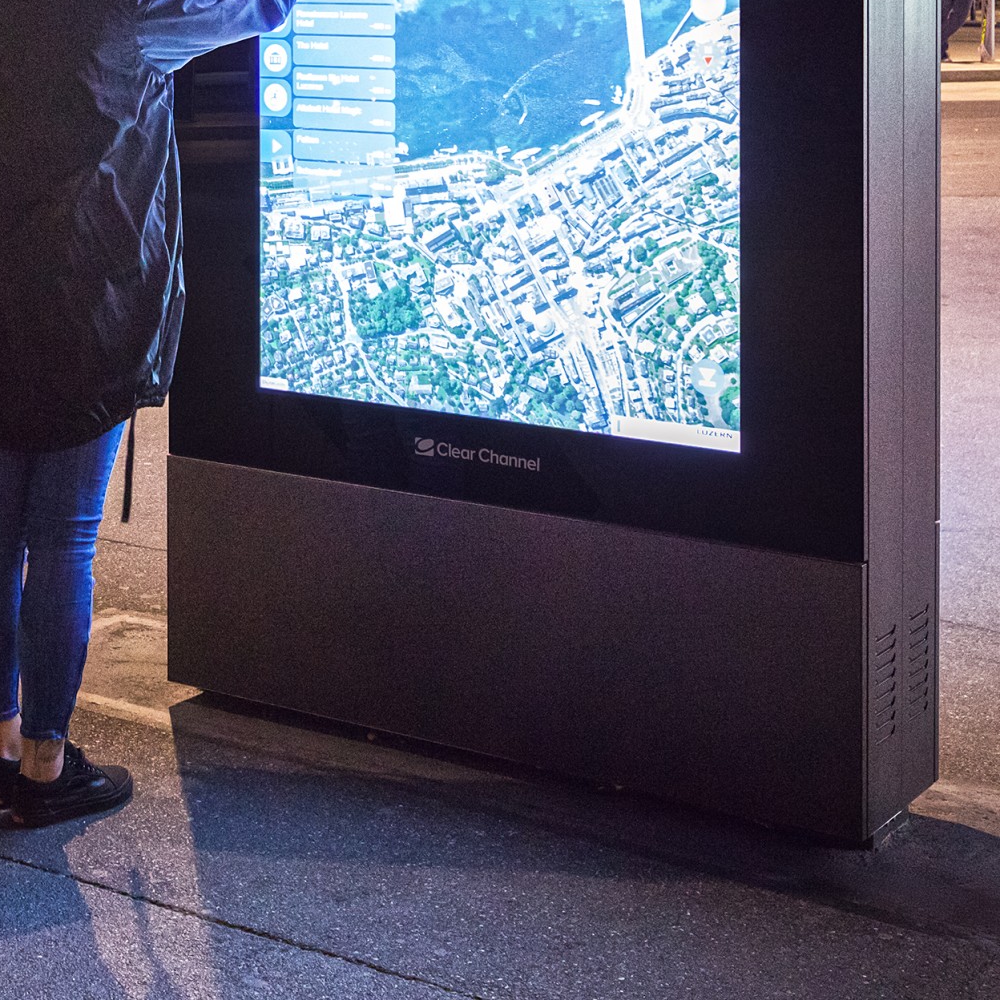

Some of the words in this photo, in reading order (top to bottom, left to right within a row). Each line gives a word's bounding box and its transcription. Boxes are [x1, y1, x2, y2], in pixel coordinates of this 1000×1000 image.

[696, 429, 733, 439] LUZERN
[436, 442, 476, 461] Clear
[478, 448, 540, 472] Channel
